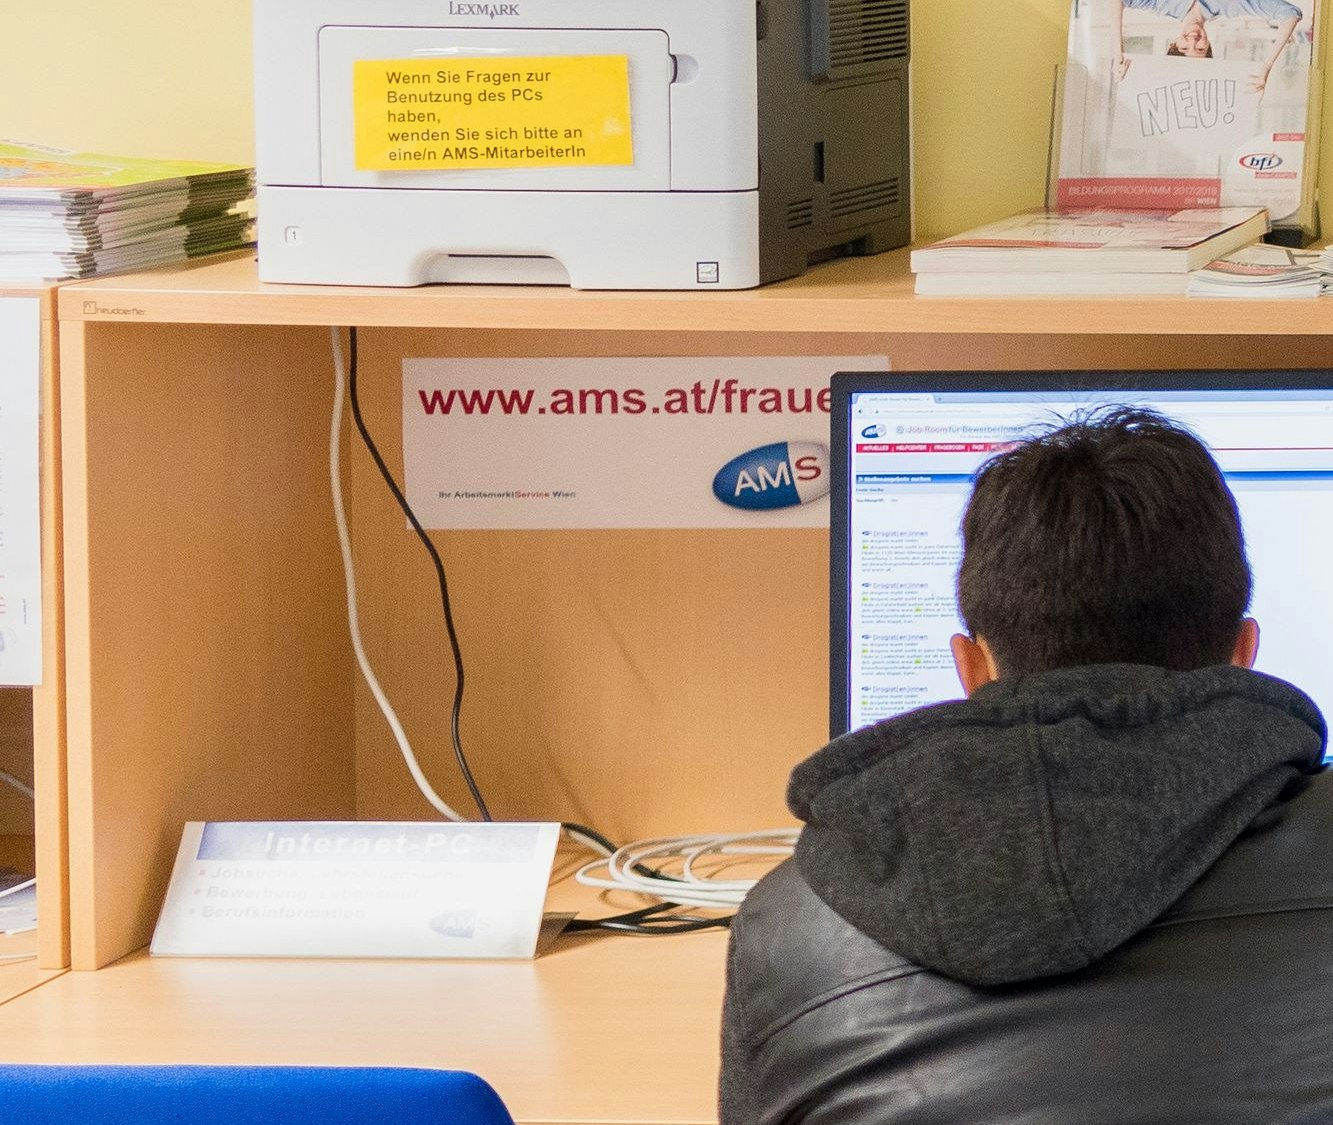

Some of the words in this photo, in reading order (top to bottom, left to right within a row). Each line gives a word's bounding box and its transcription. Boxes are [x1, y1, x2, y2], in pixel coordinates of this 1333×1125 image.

[449, 2, 520, 18] LEXMARK
[386, 71, 431, 84] Wenn
[436, 71, 461, 84] Sie
[466, 70, 521, 86] Fragen
[526, 71, 551, 82] zur
[387, 90, 472, 105] Benutzung
[478, 89, 506, 102] des
[511, 88, 543, 101] PCs
[1137, 79, 1236, 137] NEU!
[387, 110, 441, 124] haben,
[388, 129, 450, 142] wenden
[455, 128, 480, 141] Sie
[485, 127, 518, 140] sich
[524, 126, 558, 139] bitte
[564, 128, 583, 139] an
[388, 147, 437, 161] eine/n
[291, 229, 297, 240] 1
[418, 379, 831, 415] www.ams.at/fraue
[734, 456, 822, 497] AMS
[264, 830, 475, 855] Internet-PC
